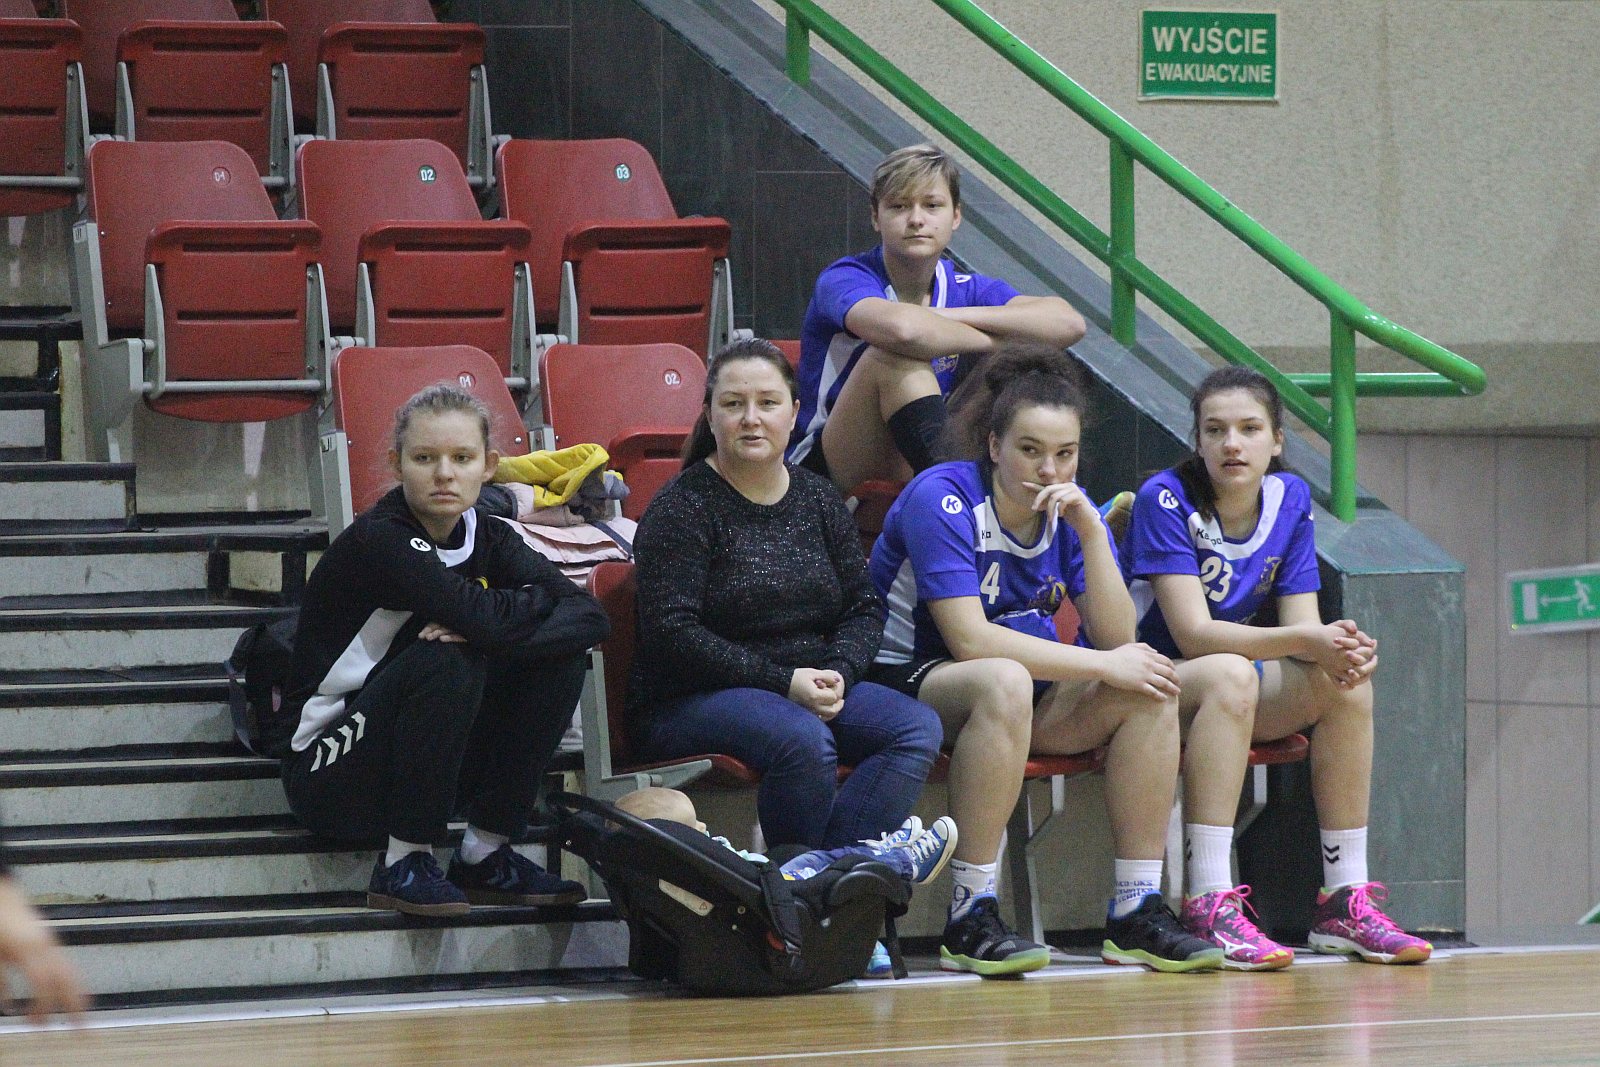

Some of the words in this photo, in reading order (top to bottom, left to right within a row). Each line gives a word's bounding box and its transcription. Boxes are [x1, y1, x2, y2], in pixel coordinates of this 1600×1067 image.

[1151, 20, 1268, 54] WYJŚCIE
[1145, 62, 1272, 83] EWAKUACYJNE
[420, 169, 435, 181] 02
[616, 167, 630, 179] 03
[664, 373, 680, 385] 02
[980, 561, 1000, 605] 4
[1200, 556, 1233, 603] 23
